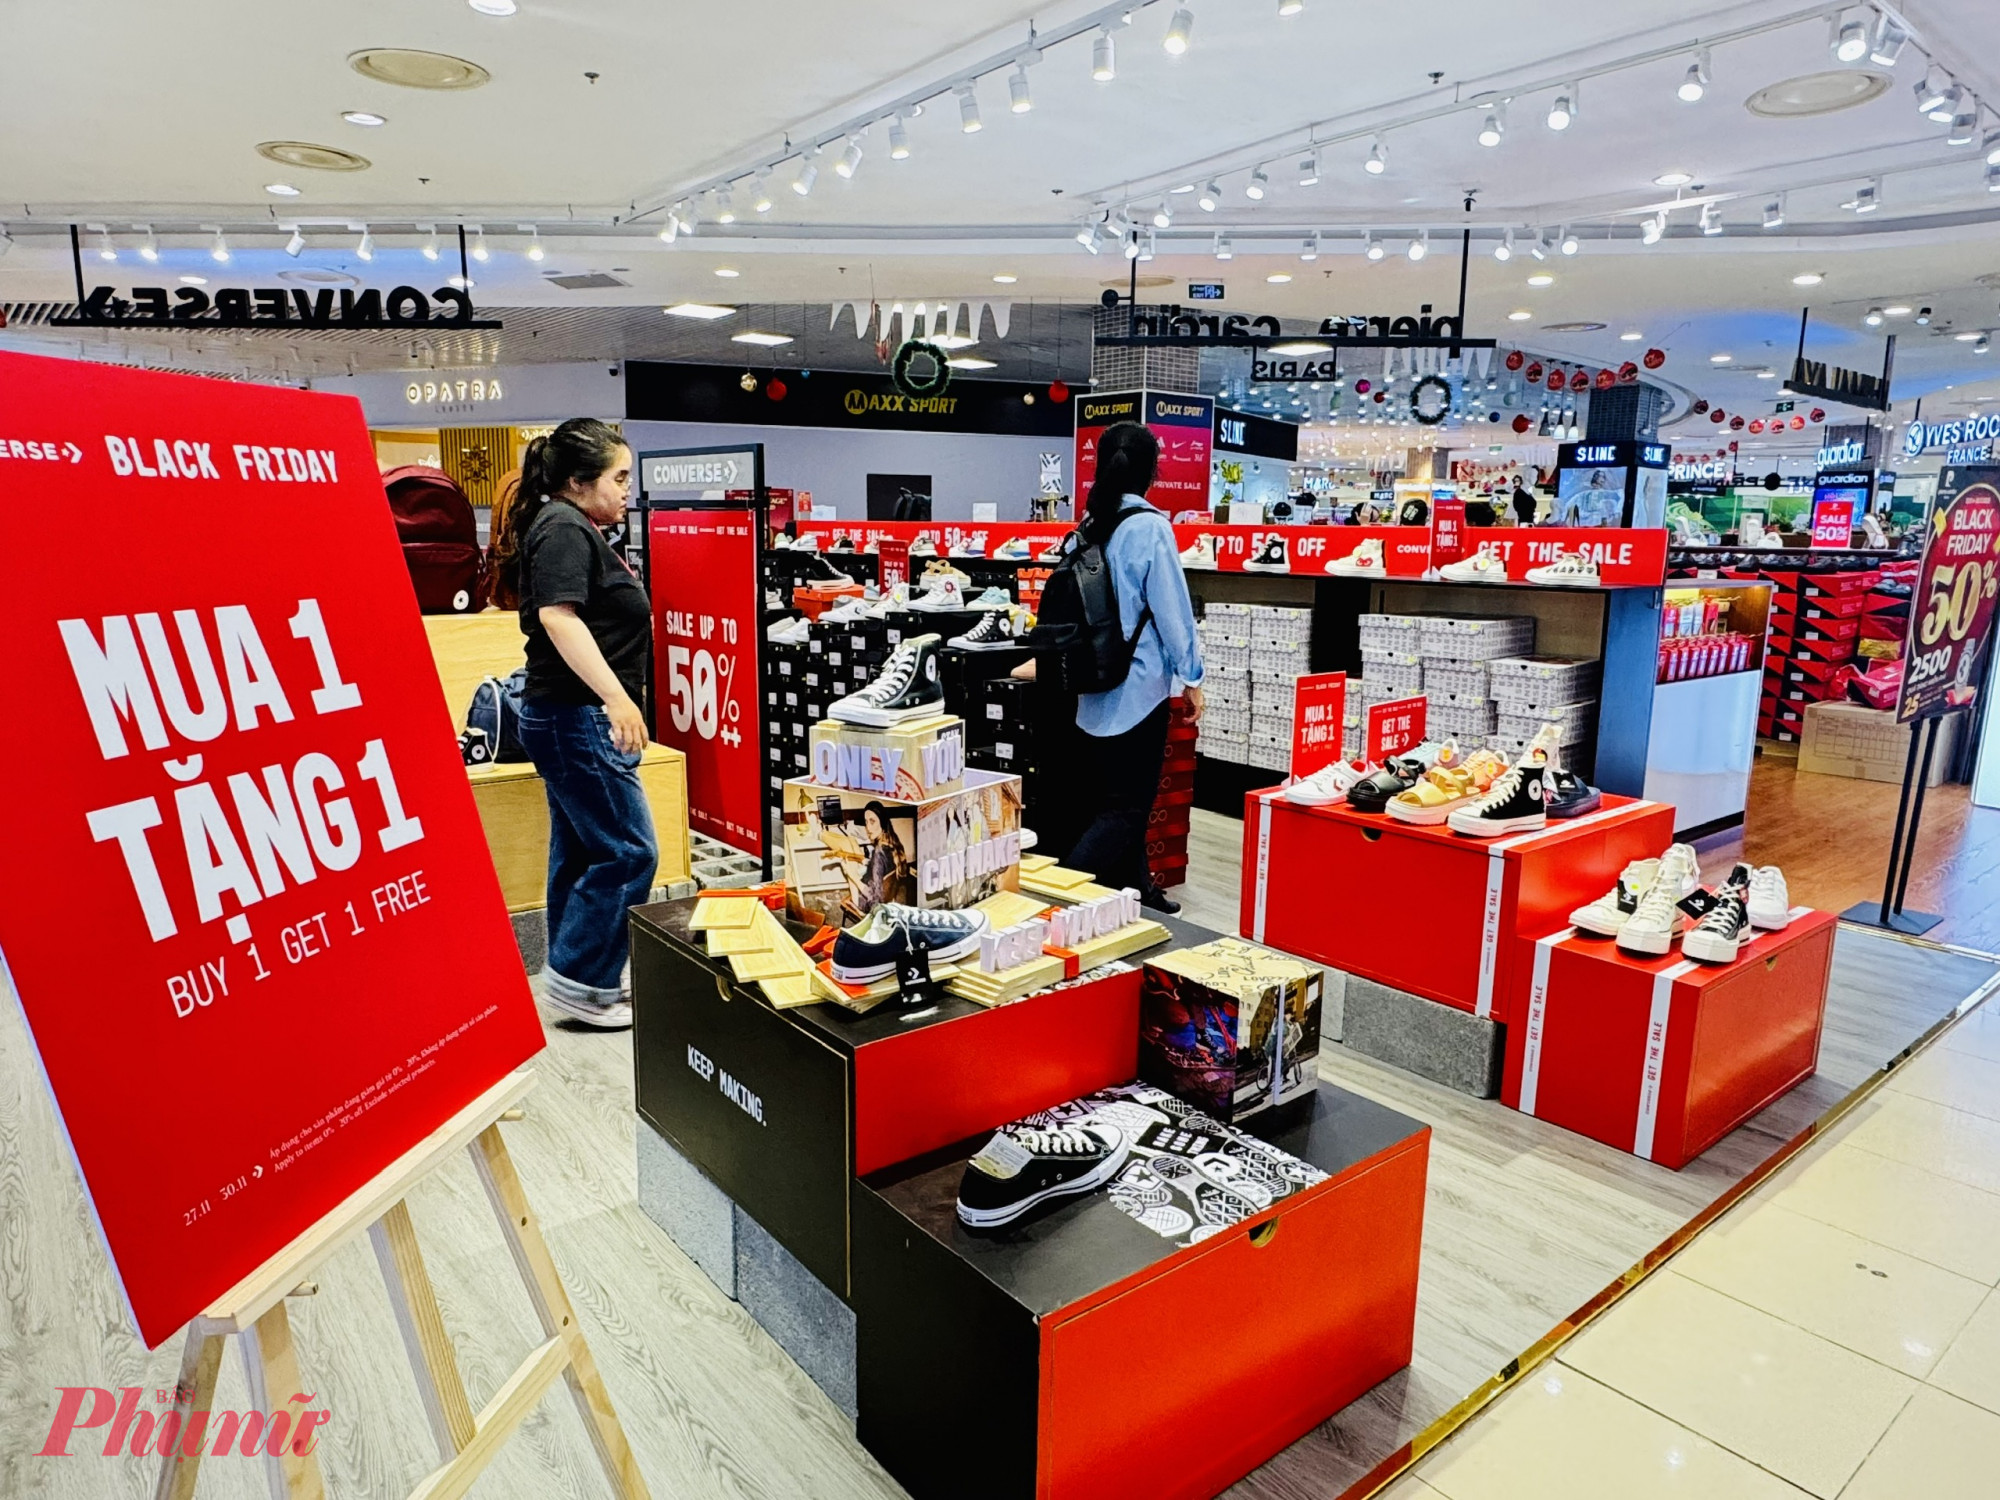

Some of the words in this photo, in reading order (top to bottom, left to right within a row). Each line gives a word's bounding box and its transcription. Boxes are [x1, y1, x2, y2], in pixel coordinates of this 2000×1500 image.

[406, 379, 503, 404] OPATRA
[844, 389, 905, 414] MAXX
[909, 397, 957, 414] SPORT
[1084, 404, 1110, 420] MAXX
[1111, 402, 1134, 415] SPORT
[1156, 401, 1182, 417] MAXX
[1183, 405, 1204, 418] SPORT
[1925, 420, 1961, 447] YVES
[104, 435, 220, 480] BLACK
[232, 444, 338, 483] FRIDAY
[1816, 437, 1864, 471] guardian
[1946, 446, 1987, 464] FRANCE
[653, 463, 723, 484] CONVERSE
[1818, 474, 1868, 485] guardian
[1152, 481, 1182, 490] PRIVATE
[1184, 482, 1201, 490] SALE
[1820, 515, 1848, 524] SALE
[1953, 508, 1995, 531] BLACK
[1227, 535, 1244, 555] TO
[1297, 537, 1327, 557] OFF
[1478, 540, 1512, 562] GET
[1528, 542, 1571, 562] THE
[1579, 542, 1632, 565] SALE
[1946, 532, 1992, 557] FRIDAY
[1920, 560, 1998, 646] 50%
[666, 610, 694, 638] SALE
[700, 614, 715, 640] UP
[721, 618, 738, 645] TO
[1907, 645, 1952, 685] 2500
[57, 604, 295, 761] MUA
[288, 598, 363, 716] 1
[668, 644, 740, 740] 50%
[1304, 705, 1325, 723] MUA
[1326, 704, 1334, 720] 1
[1381, 718, 1396, 734] GET
[1396, 715, 1411, 730] THE
[1301, 722, 1328, 747] TẶNG
[1328, 724, 1335, 742] 1
[1381, 734, 1398, 752] SALE
[814, 740, 905, 793] ONLY
[919, 734, 962, 790] YOU
[85, 752, 363, 945] TẶNG
[356, 738, 425, 853] 1
[923, 850, 966, 895] CAN
[966, 831, 1020, 880] MAKE
[1488, 888, 1498, 907] SALE
[1488, 911, 1496, 924] THE
[980, 917, 1050, 974] KEEP
[1050, 887, 1142, 948] MAKING
[1486, 929, 1494, 943] GET
[166, 956, 229, 1019] BUY
[246, 942, 272, 982] 1
[280, 911, 332, 964] GET
[344, 900, 365, 936] 1
[371, 869, 432, 923] FREE
[1533, 984, 1543, 1004] SALE
[1531, 1008, 1541, 1022] THE
[1530, 1026, 1538, 1040] GET
[1651, 1021, 1662, 1042] SALE
[1649, 1046, 1659, 1061] THE
[1647, 1066, 1656, 1081] GET
[688, 1044, 714, 1082] KEEP
[720, 1068, 767, 1127] MAKING.
[274, 1156, 295, 1174] Apply
[218, 1174, 249, 1202] 30.11
[182, 1200, 212, 1227] 27.11
